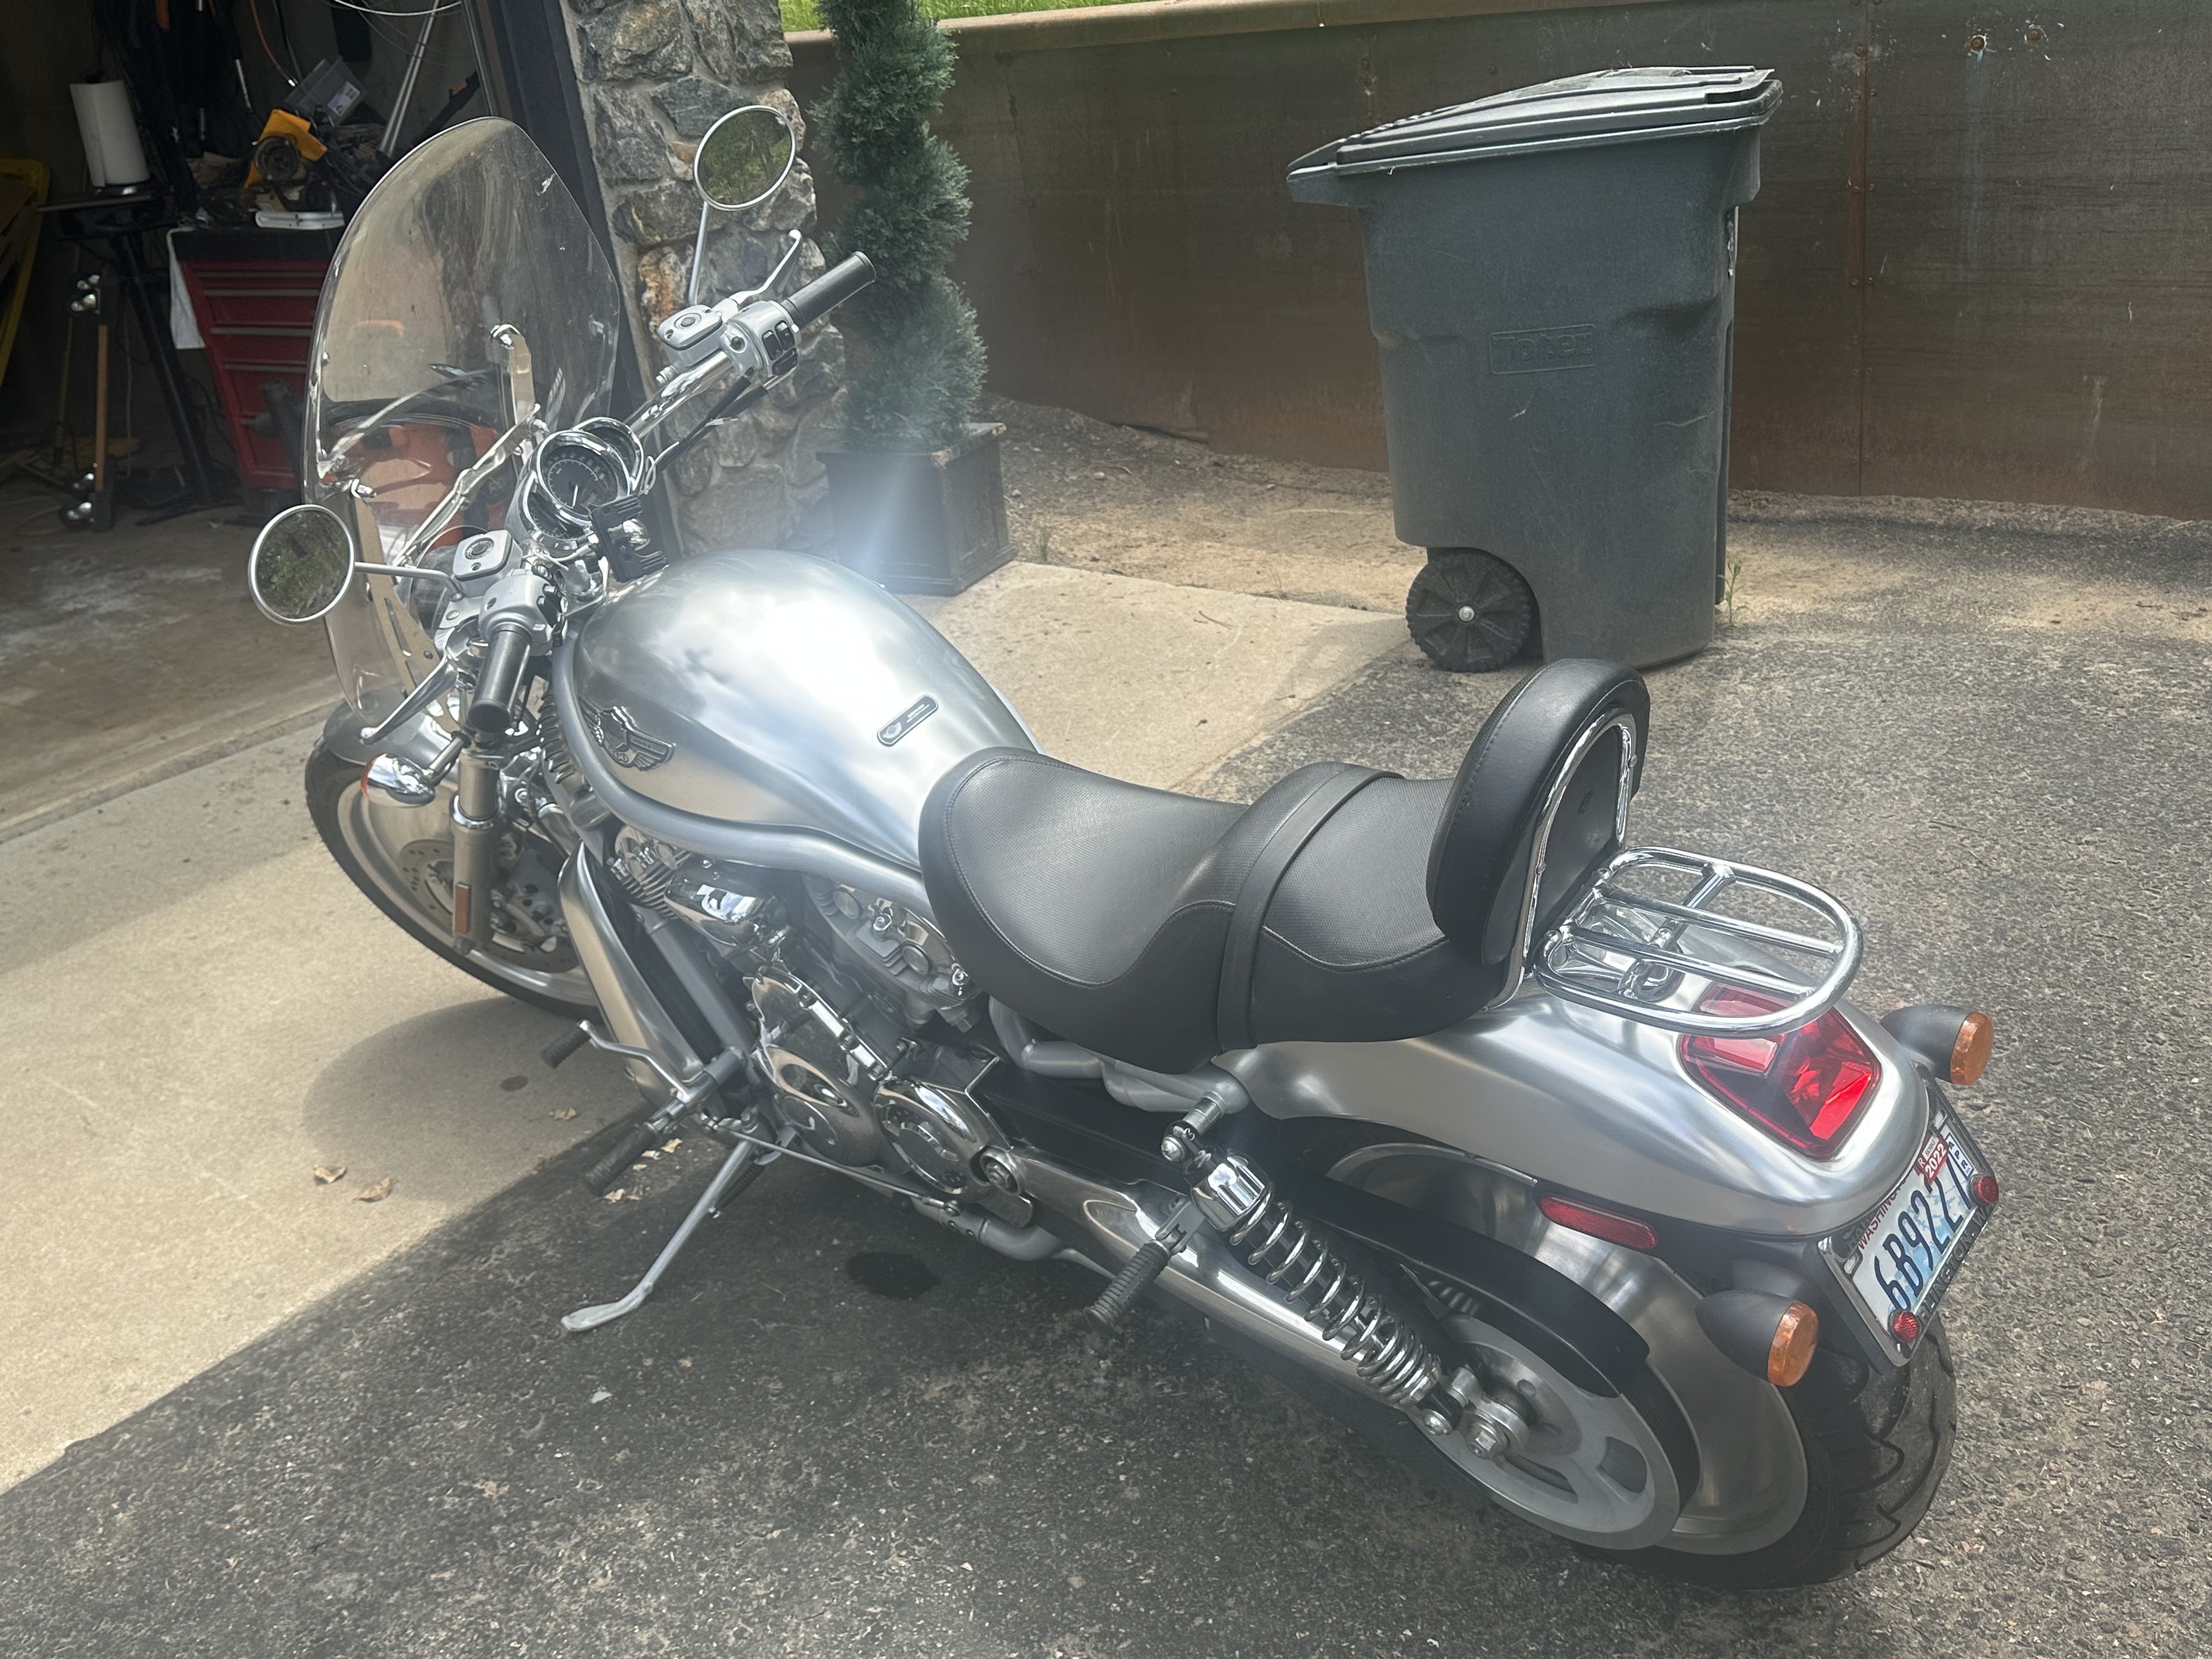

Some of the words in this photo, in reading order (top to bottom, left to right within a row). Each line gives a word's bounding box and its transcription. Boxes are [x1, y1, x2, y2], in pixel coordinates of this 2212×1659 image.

[1917, 1157, 1926, 1169] R
[1925, 1143, 1946, 1178] 2022
[1858, 1174, 1910, 1250] WASHING
[1919, 1229, 1976, 1325] RLINGTON,
